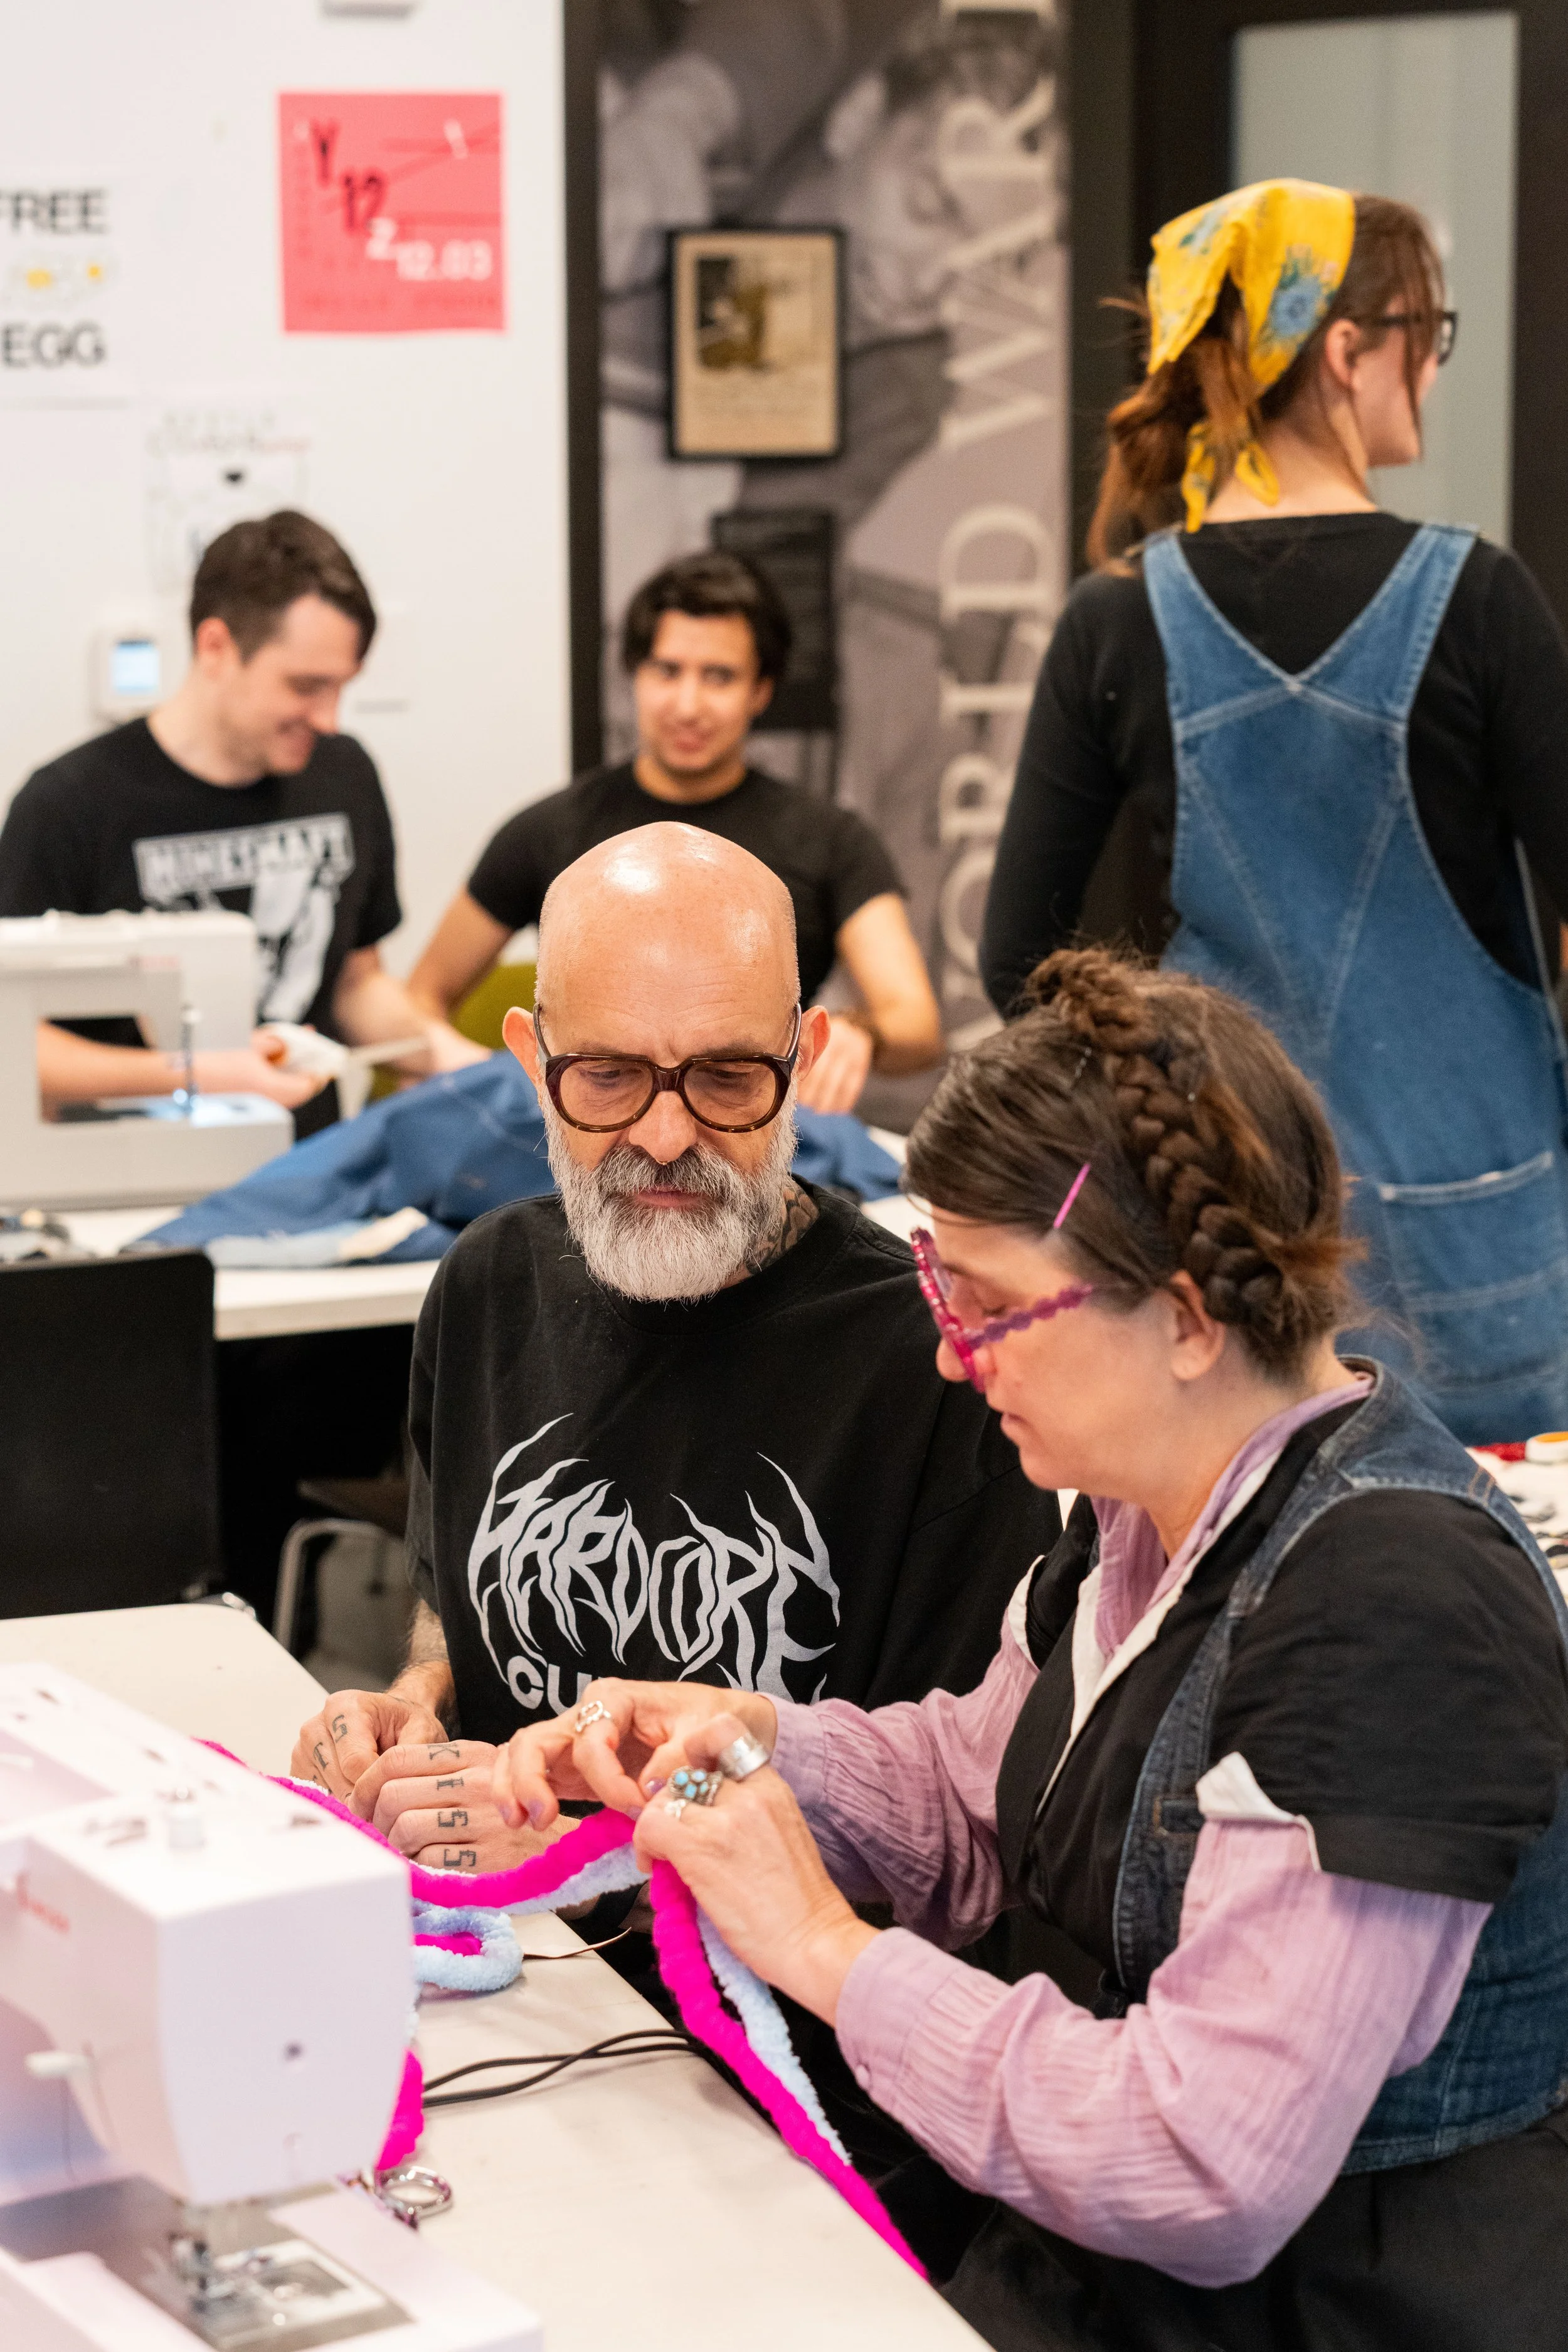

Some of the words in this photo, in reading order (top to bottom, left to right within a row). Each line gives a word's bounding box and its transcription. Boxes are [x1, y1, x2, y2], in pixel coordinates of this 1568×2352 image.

[936, 70, 1059, 453] WAR
[3, 321, 107, 369] EGG
[507, 1656, 602, 1717] CU
